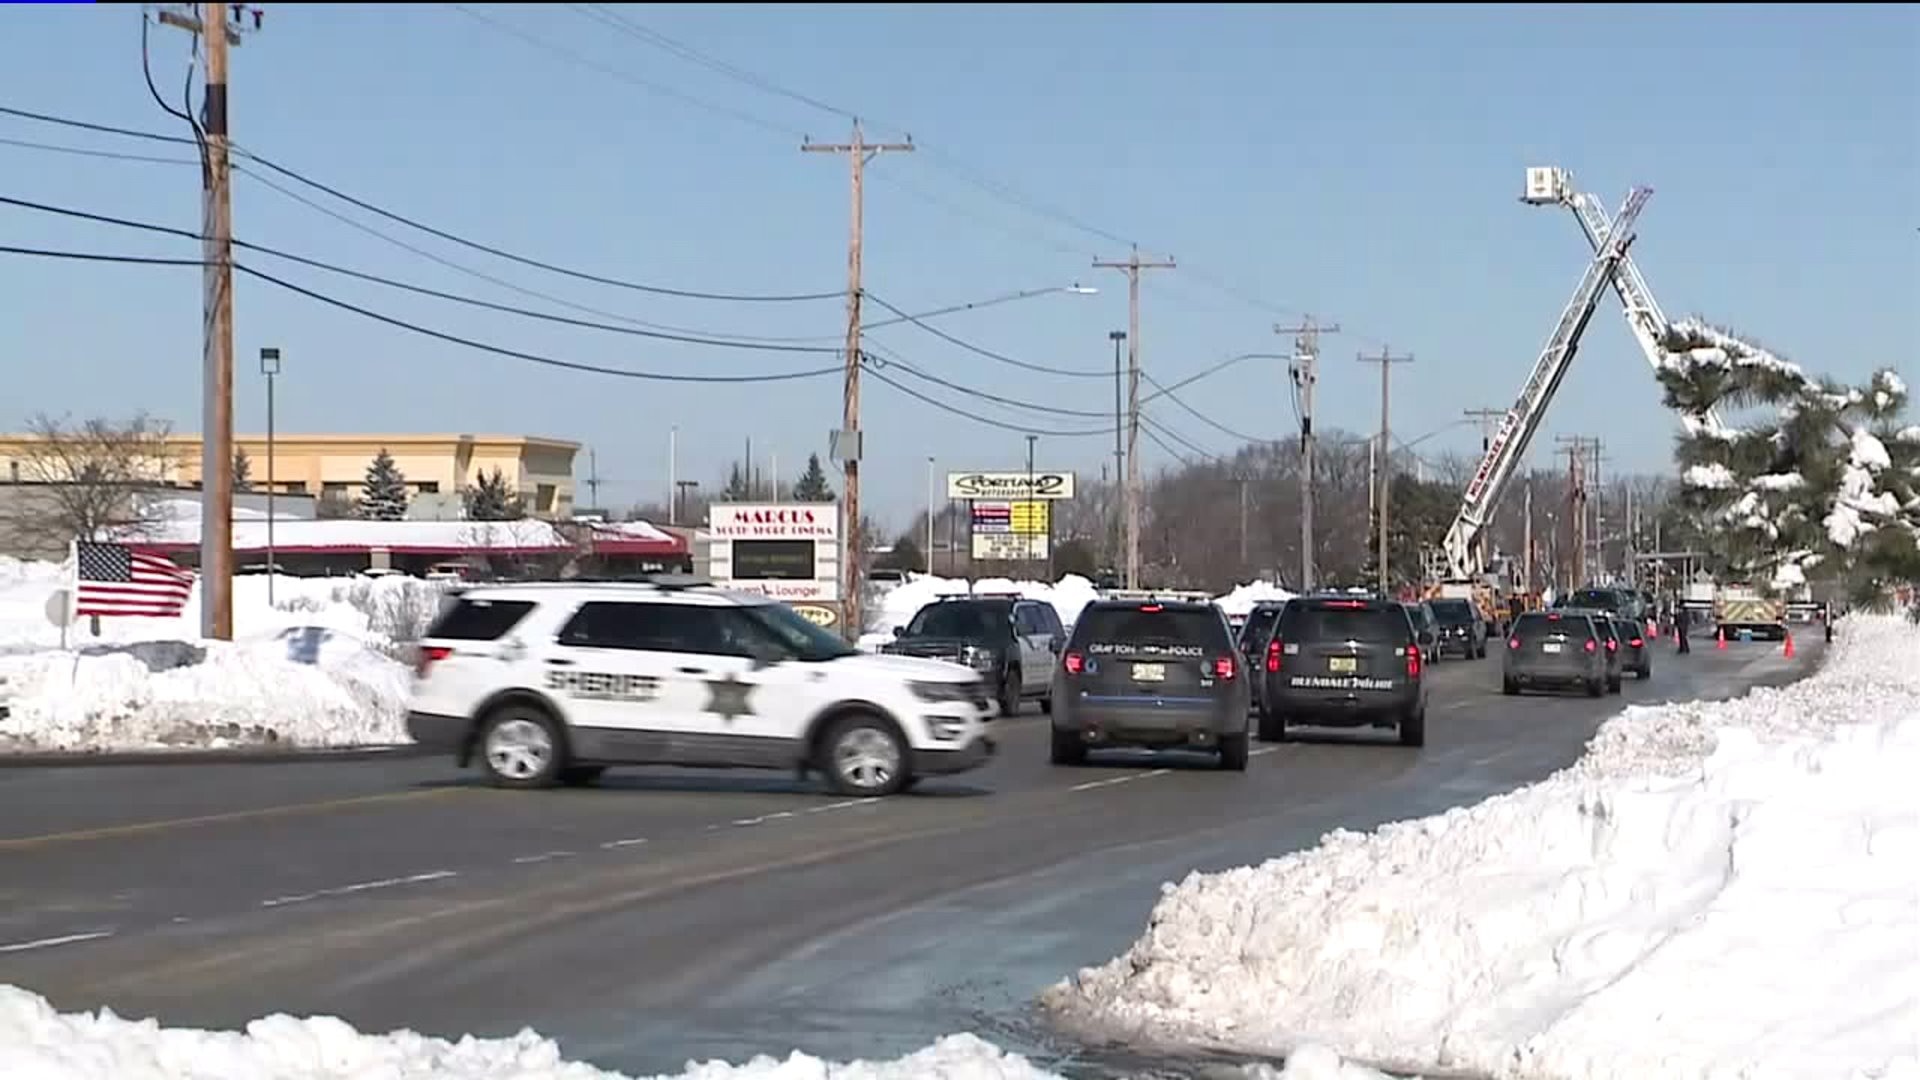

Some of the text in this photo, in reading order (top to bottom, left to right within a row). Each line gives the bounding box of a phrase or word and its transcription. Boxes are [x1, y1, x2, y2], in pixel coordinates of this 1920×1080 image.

[1469, 440, 1503, 497] MILWAUKEE
[735, 510, 814, 523] MARCUS
[791, 527, 834, 536] CINEMA
[1169, 644, 1204, 656] POLICE
[543, 670, 661, 694] SHERIFF
